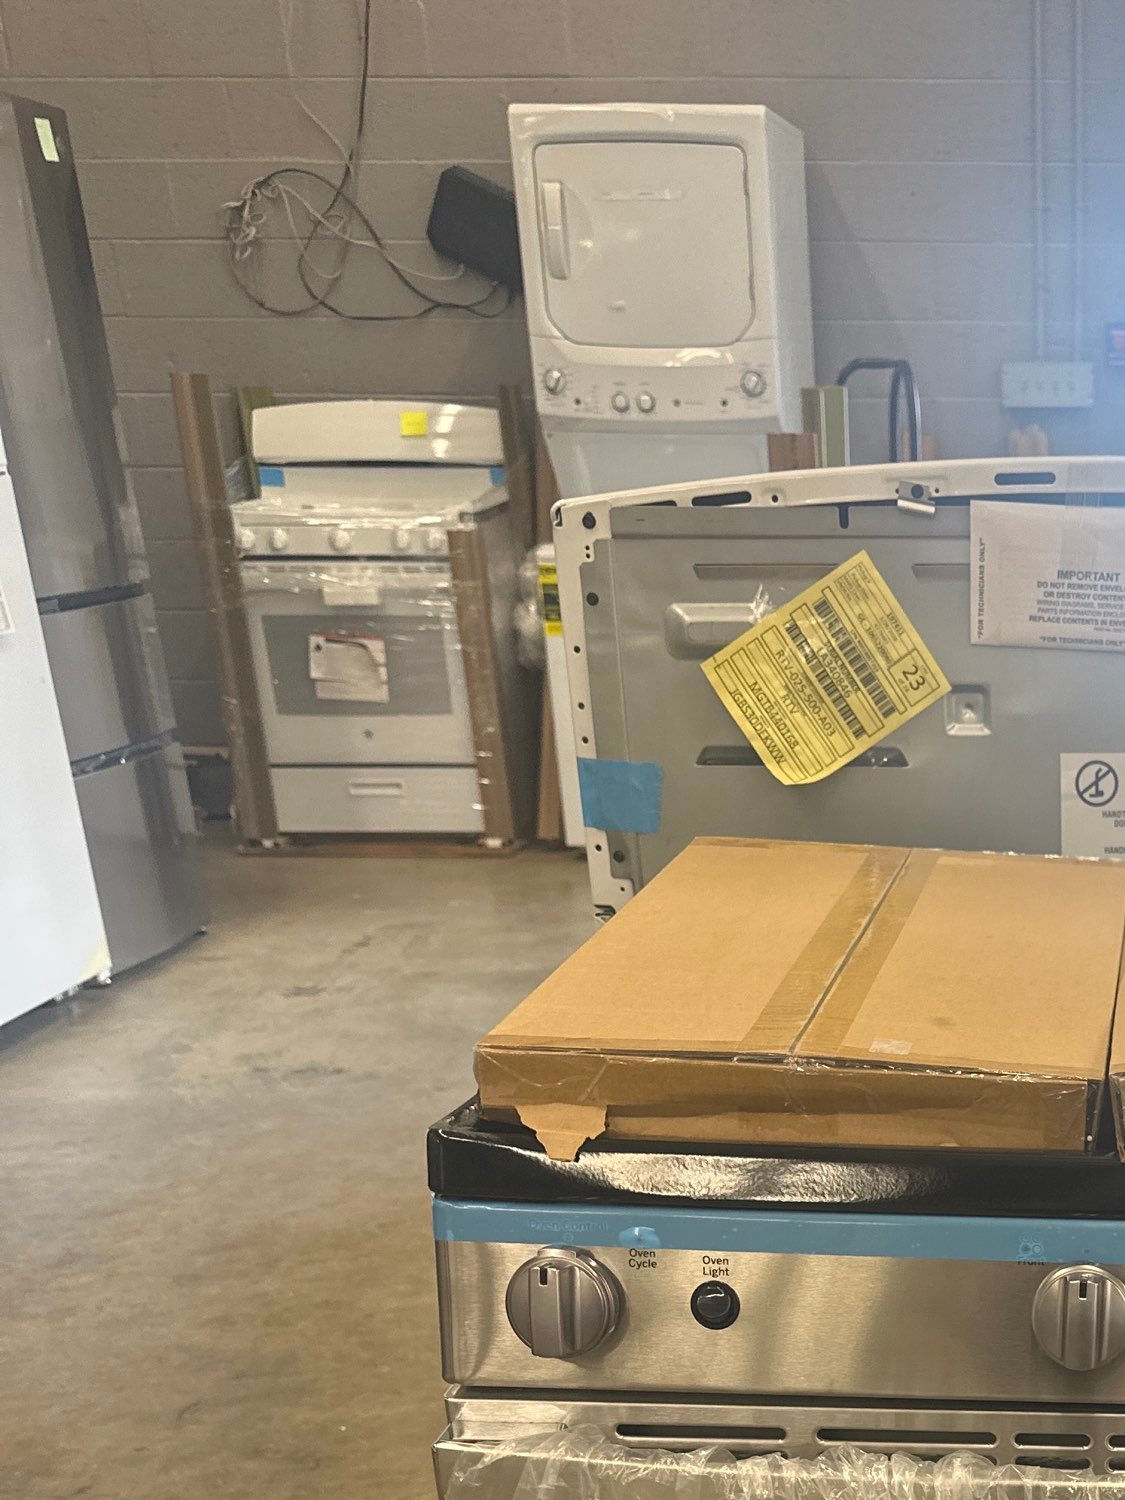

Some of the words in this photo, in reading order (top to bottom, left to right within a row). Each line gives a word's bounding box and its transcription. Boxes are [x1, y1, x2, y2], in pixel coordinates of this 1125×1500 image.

[1057, 570, 1120, 582] IMPORTANT
[1067, 583, 1098, 591] REMOVE
[1056, 592, 1091, 600] DESTROY
[1029, 615, 1060, 624] REPLACE
[1062, 616, 1098, 625] CONTENTS
[901, 663, 927, 692] 23
[780, 693, 799, 716] RTV
[630, 1248, 656, 1258] Oven
[628, 1258, 658, 1269] Cycle
[702, 1255, 729, 1265] Oven
[703, 1266, 730, 1278] Light
